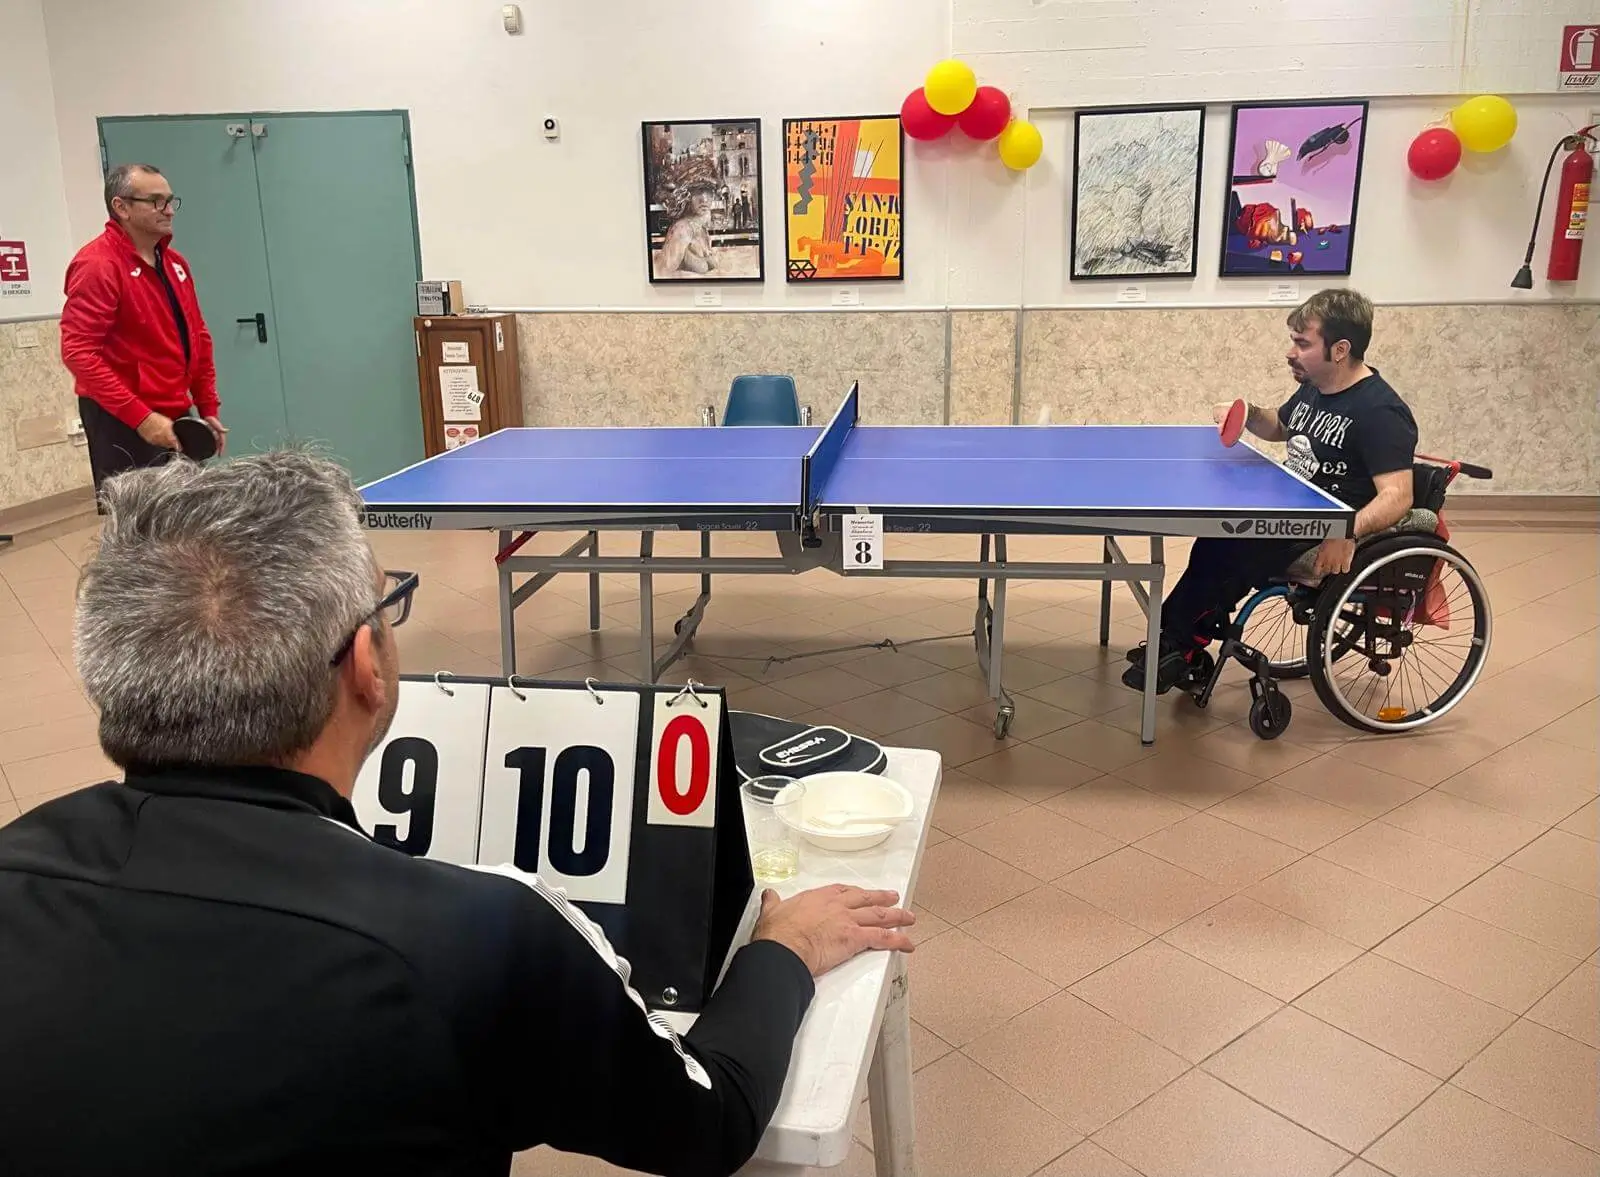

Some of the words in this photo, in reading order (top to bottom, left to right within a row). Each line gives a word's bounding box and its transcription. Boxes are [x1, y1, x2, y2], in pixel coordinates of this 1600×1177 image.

[1287, 401, 1314, 431] NEW
[1307, 409, 1354, 450] YORK
[367, 513, 433, 530] Butterfly
[744, 520, 758, 530] 22
[1254, 519, 1332, 539] Butterfly
[854, 541, 872, 564] 8
[373, 736, 439, 858] 9
[504, 745, 615, 877] 10
[656, 713, 711, 816] 0
